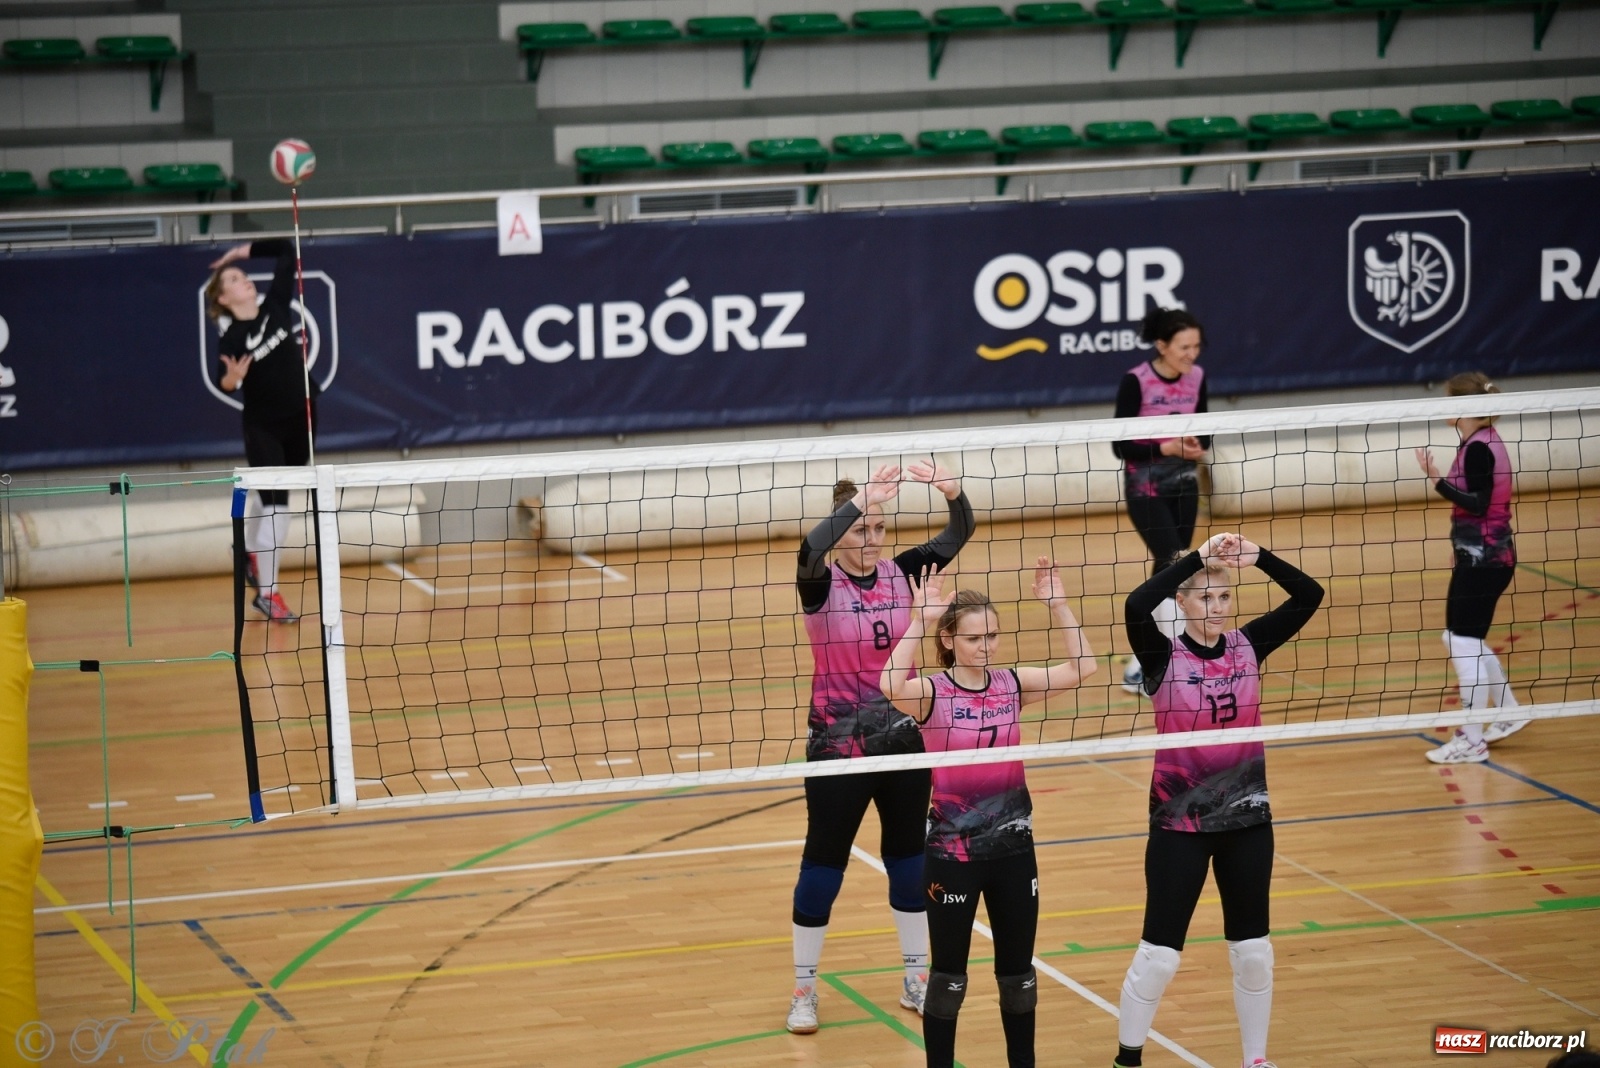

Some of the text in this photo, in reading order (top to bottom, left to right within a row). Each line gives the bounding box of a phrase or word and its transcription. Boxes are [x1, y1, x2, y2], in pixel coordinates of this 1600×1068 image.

[508, 212, 531, 241] A
[416, 277, 807, 370] RACIBÓRZ
[873, 620, 891, 650] 8
[981, 703, 1014, 720] POLAND
[1206, 692, 1238, 724] 13
[979, 724, 998, 749] 7
[942, 893, 968, 904] JSW
[1031, 877, 1039, 897] P
